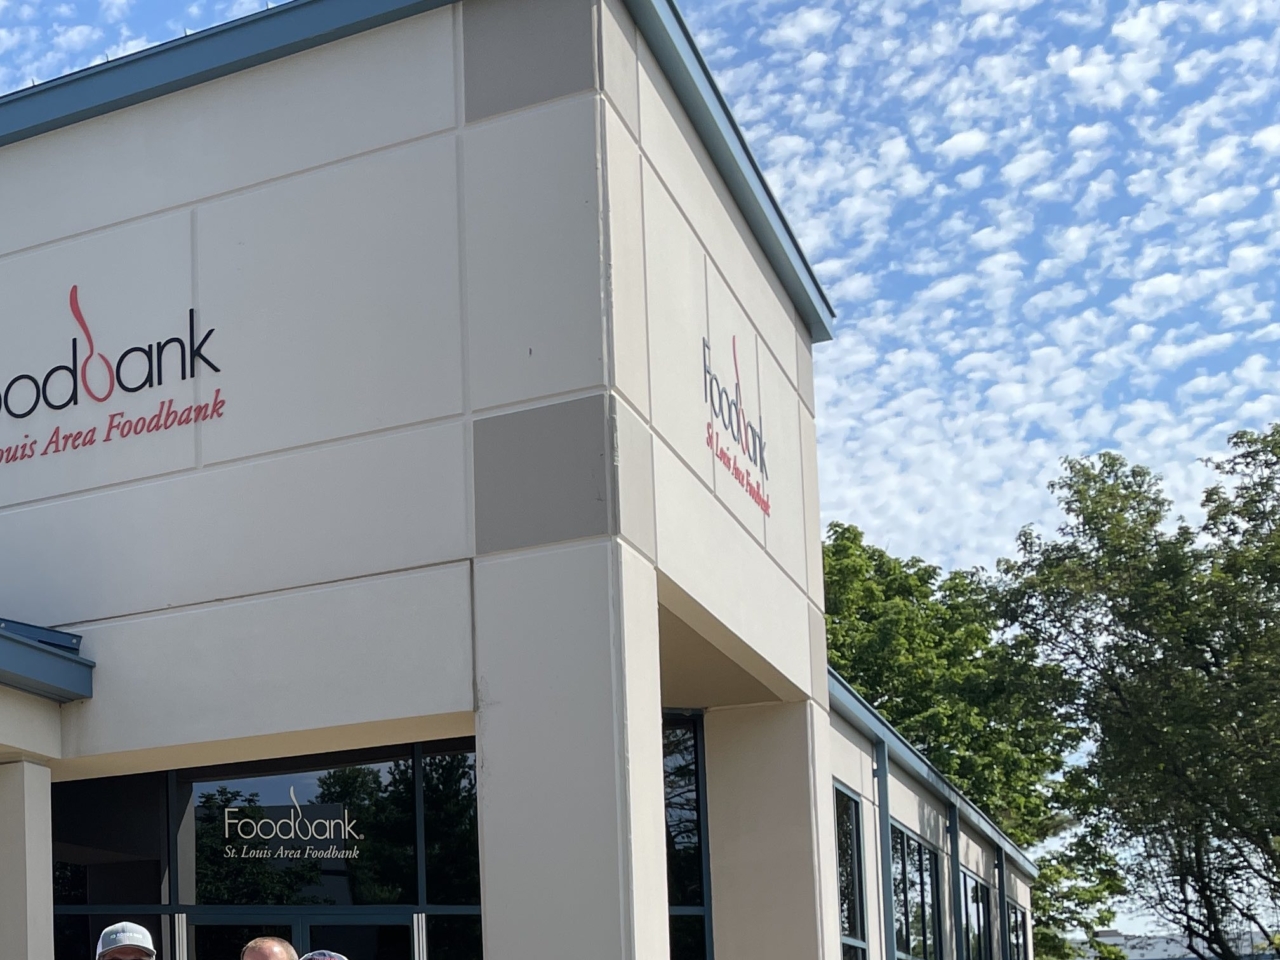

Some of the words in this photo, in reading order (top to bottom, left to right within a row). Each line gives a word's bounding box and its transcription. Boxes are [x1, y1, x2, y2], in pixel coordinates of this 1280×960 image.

[40, 426, 97, 457] Area
[103, 388, 226, 442] Foodbank
[223, 845, 238, 859] St.
[240, 845, 272, 859] Louis
[273, 845, 301, 859] Area
[303, 845, 360, 859] Foodbank
